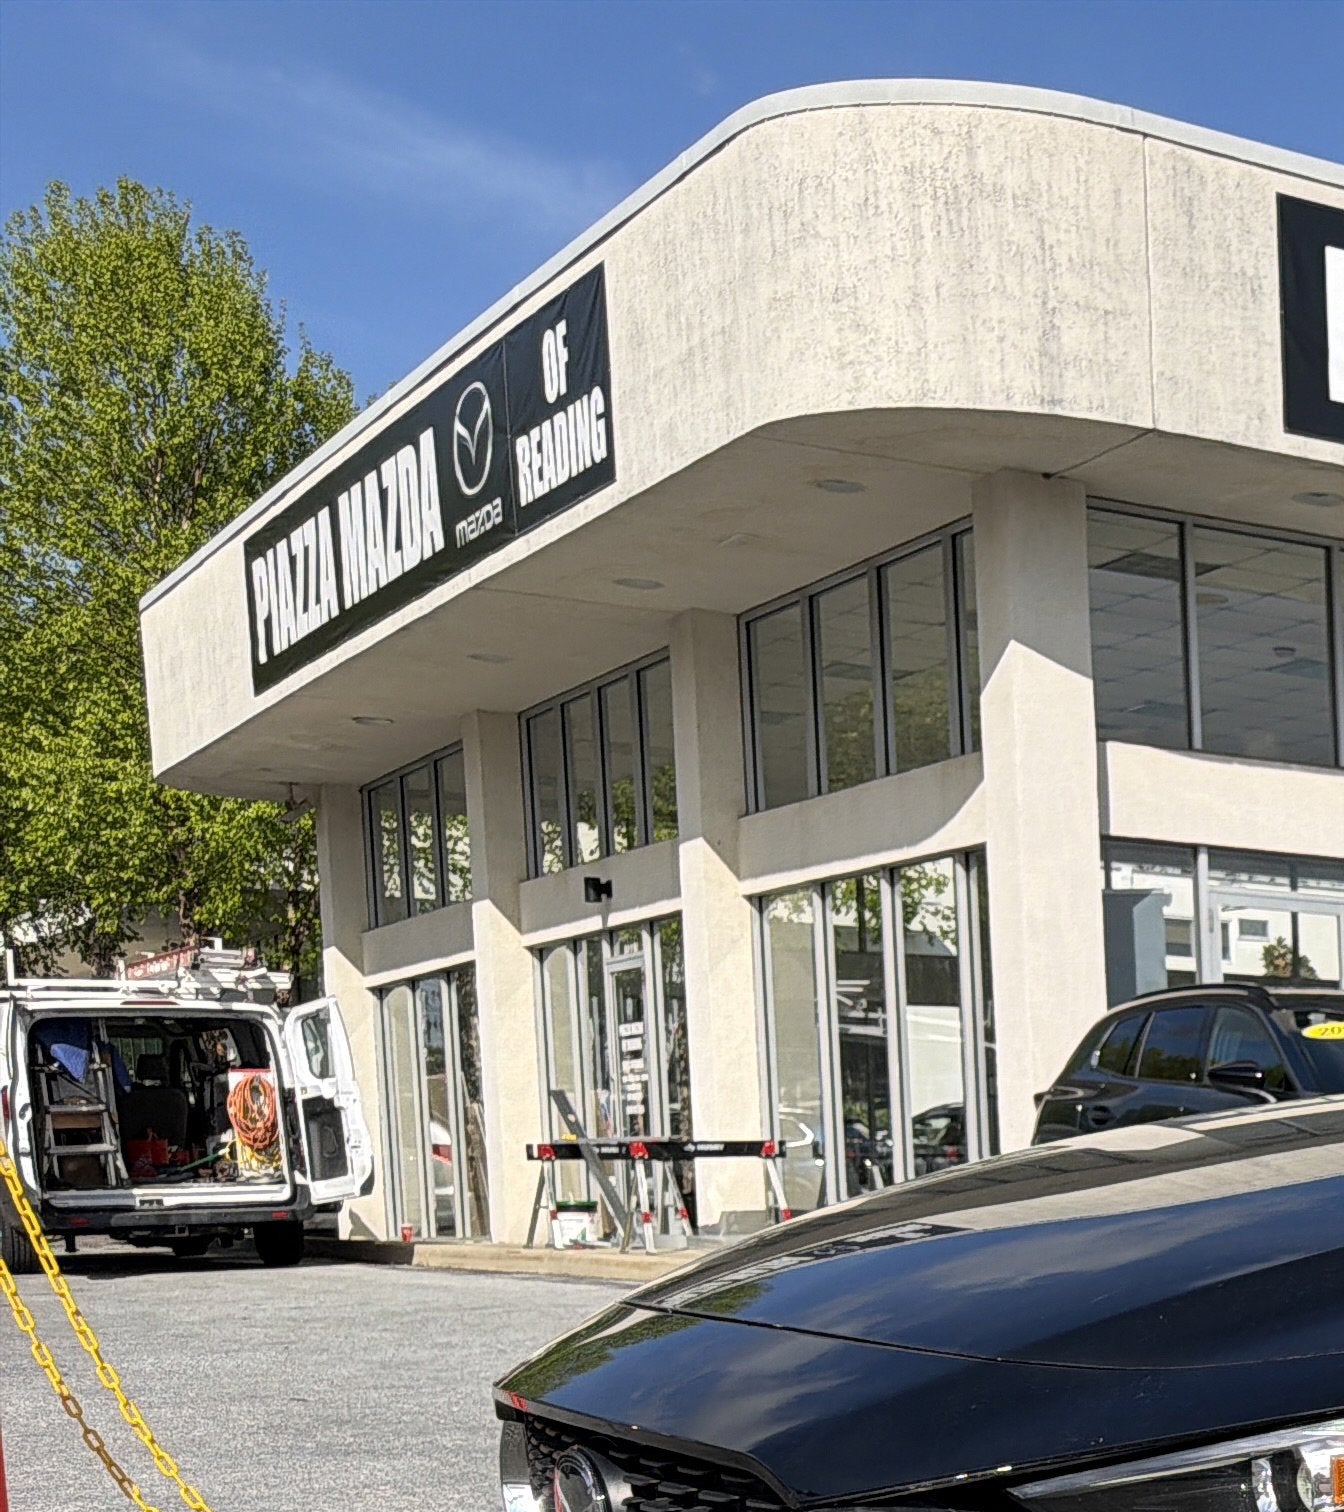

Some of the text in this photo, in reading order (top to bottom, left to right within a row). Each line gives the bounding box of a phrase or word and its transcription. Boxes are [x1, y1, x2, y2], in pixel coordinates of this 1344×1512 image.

[541, 318, 569, 404] OF
[515, 386, 607, 507] READING
[250, 427, 445, 664] PIAZZA MAZDA
[455, 496, 503, 548] mazda
